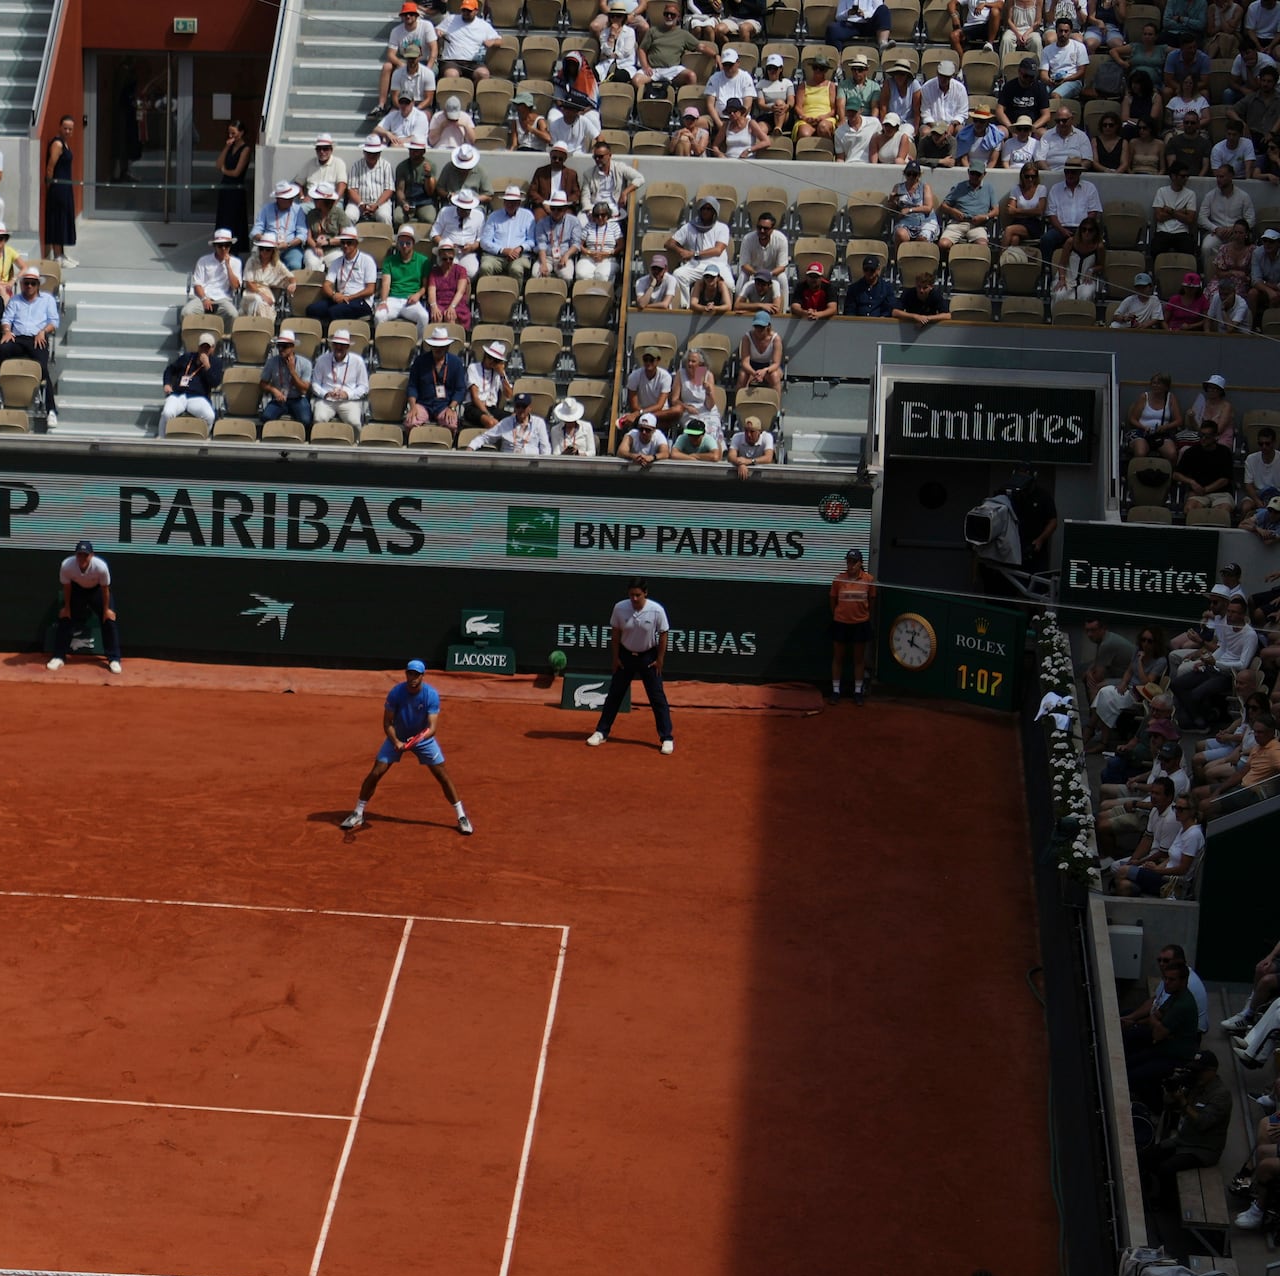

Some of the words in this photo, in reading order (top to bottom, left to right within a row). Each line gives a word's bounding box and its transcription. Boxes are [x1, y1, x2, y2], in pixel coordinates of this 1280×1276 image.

[900, 401, 1084, 446] Emirates
[118, 487, 426, 556] PARIBAS
[573, 521, 646, 552] BNP
[655, 525, 805, 560] PARIBAS
[1068, 559, 1209, 595] Emirates
[454, 653, 507, 667] LACOSTE
[955, 634, 1006, 656] ROLEX
[958, 664, 1002, 696] 1:07
